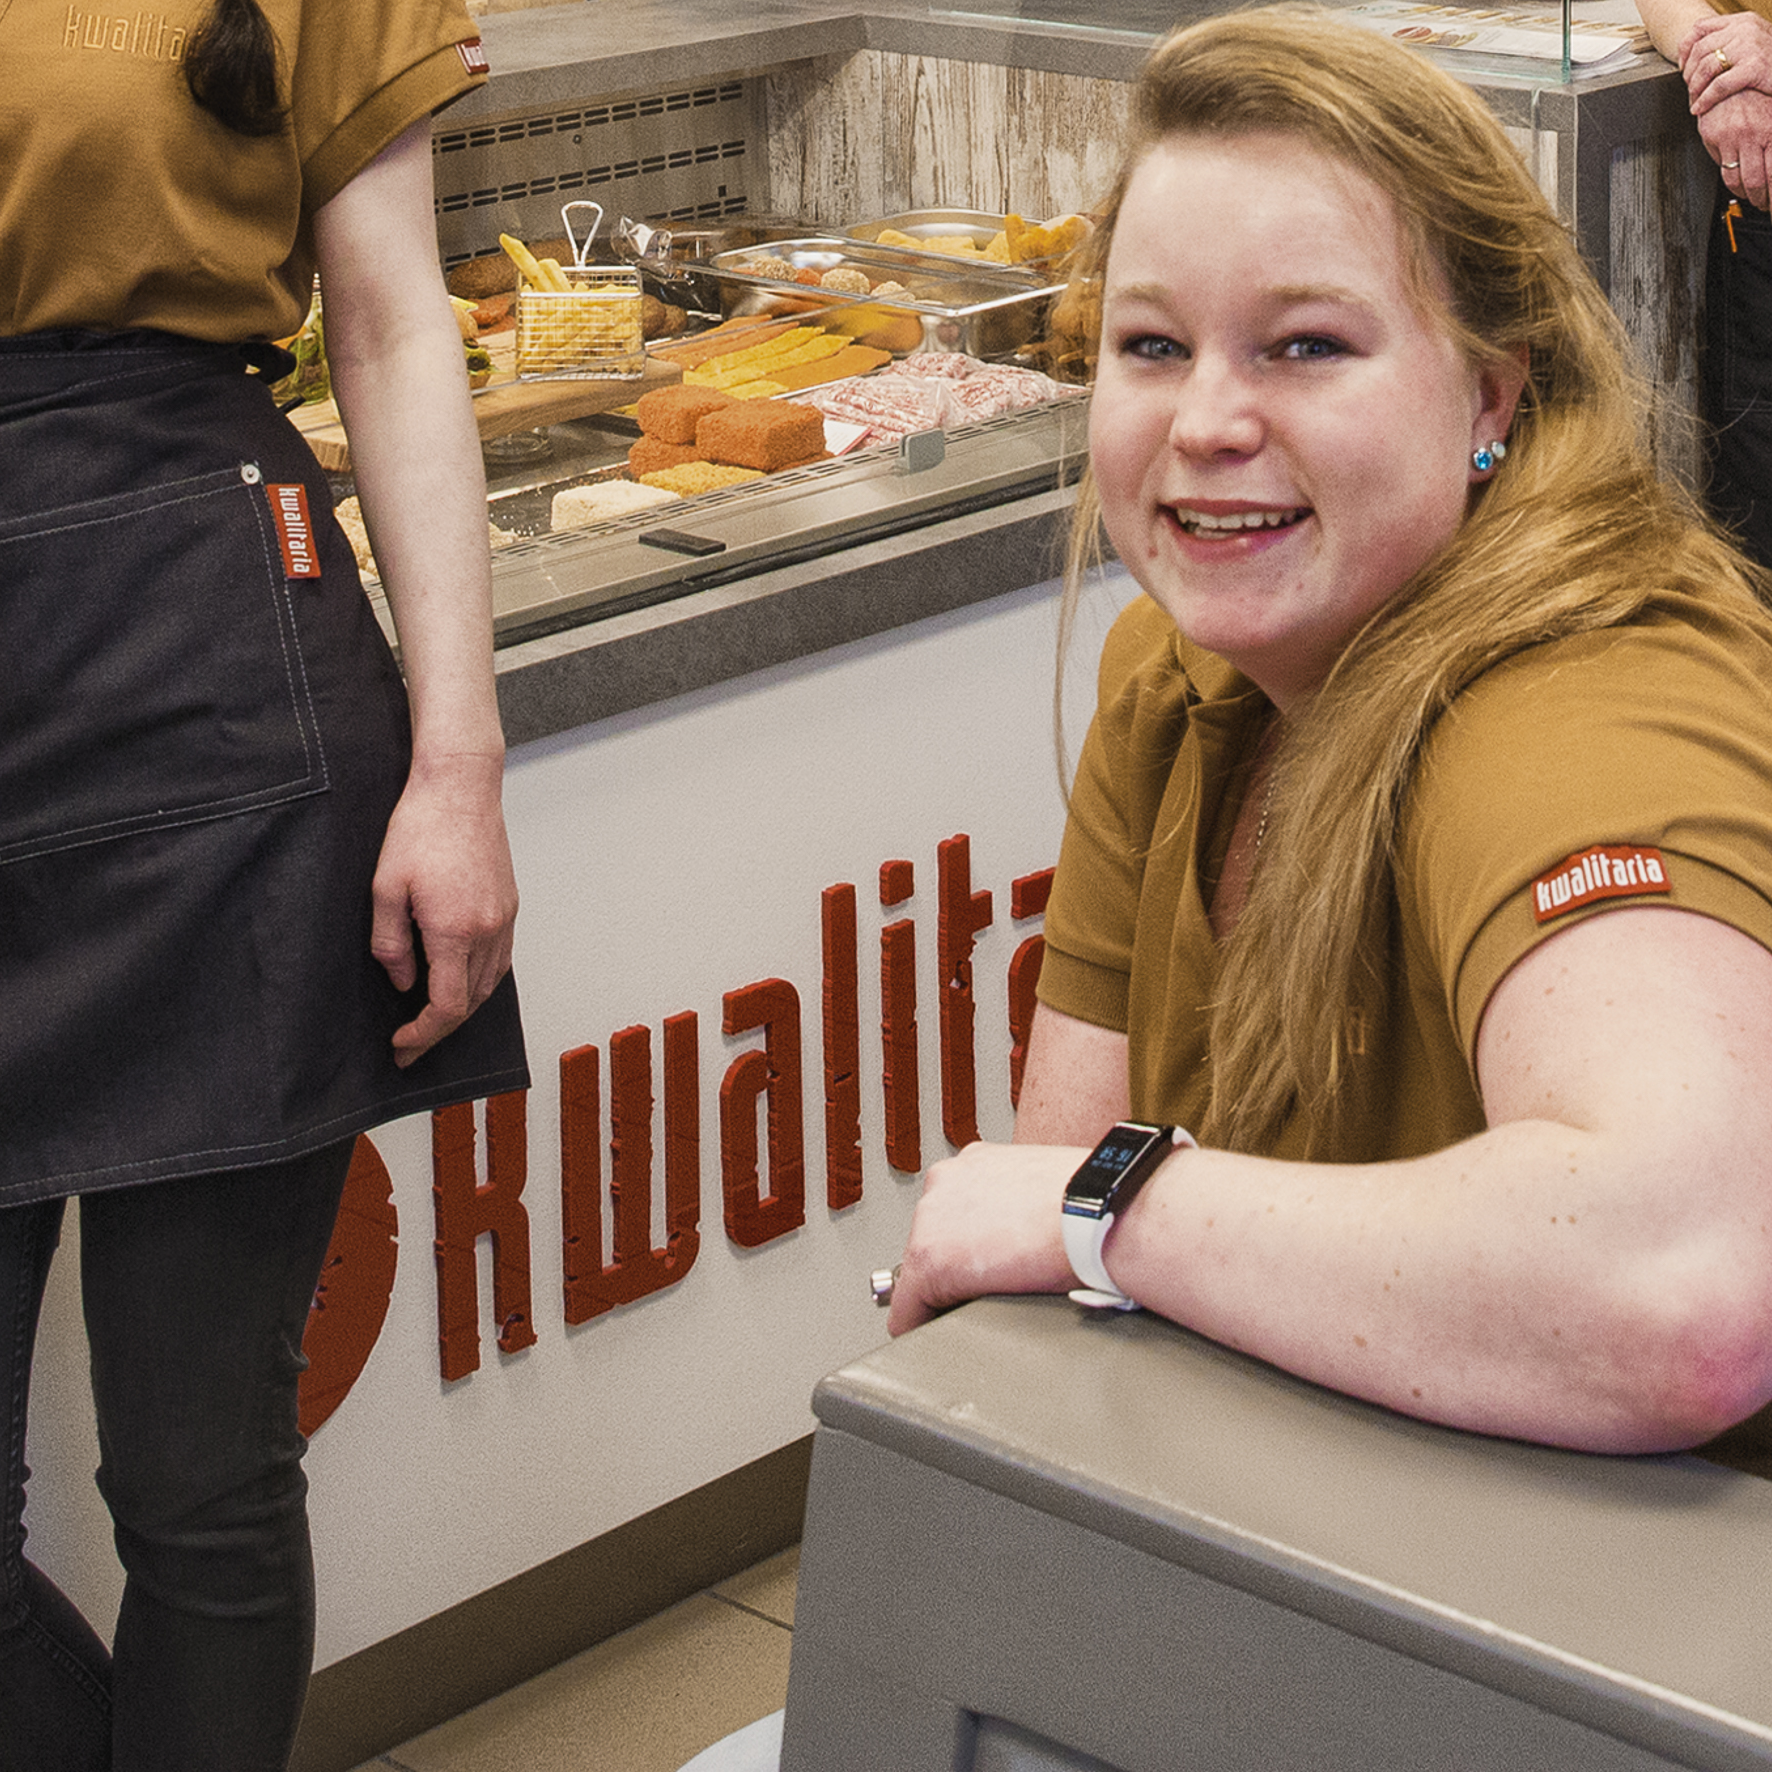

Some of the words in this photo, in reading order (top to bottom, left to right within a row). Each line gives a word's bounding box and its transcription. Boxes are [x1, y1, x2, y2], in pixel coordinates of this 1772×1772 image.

[63, 4, 189, 62] kwalita
[277, 485, 312, 575] kwalitaria
[1535, 852, 1665, 913] kwalitaria
[431, 833, 1058, 1382] kwalit
